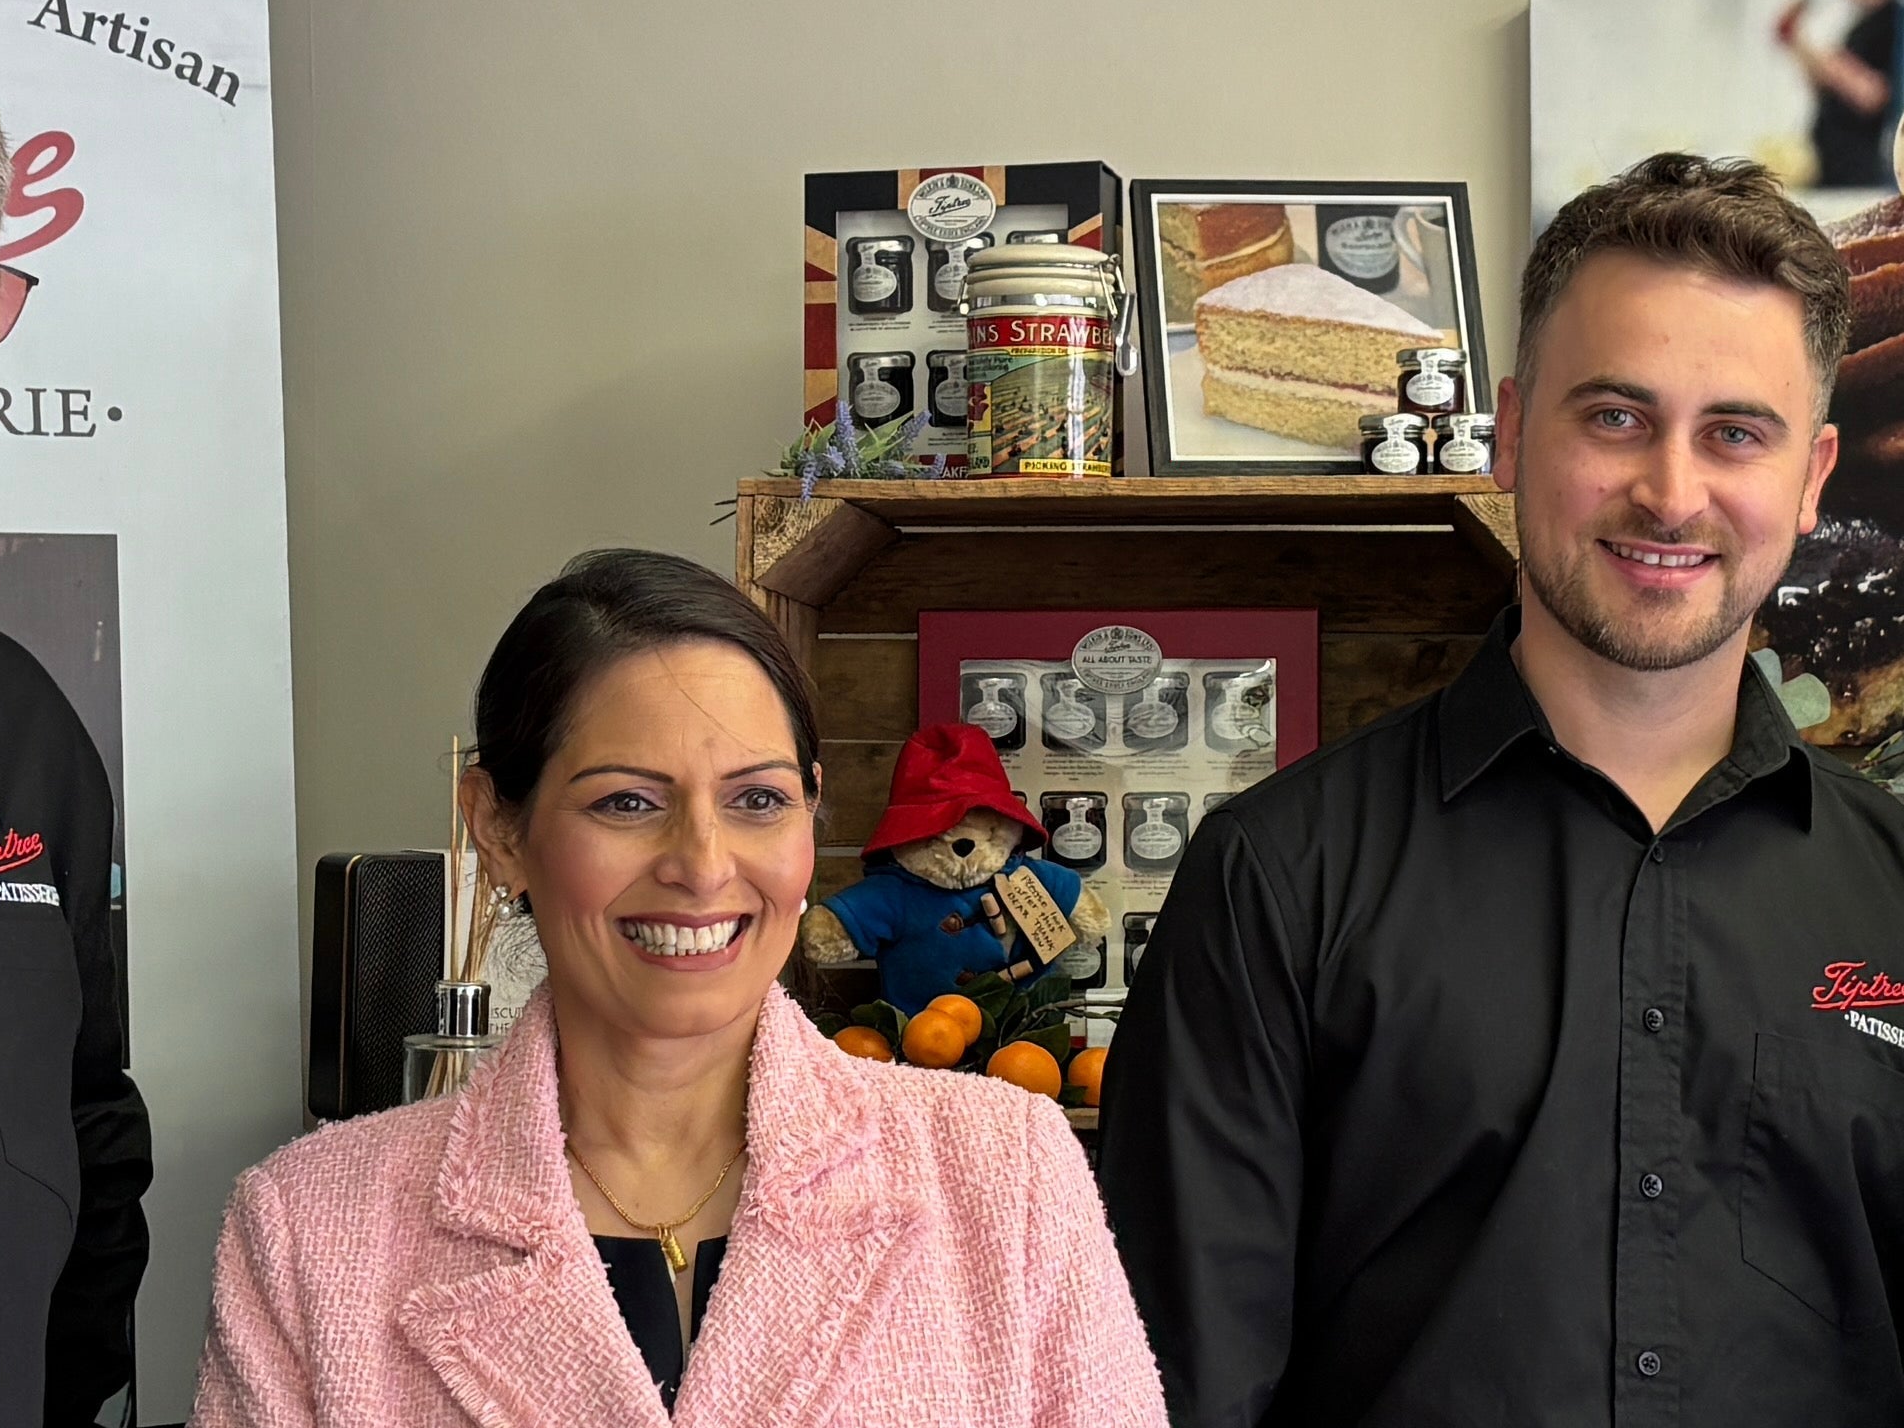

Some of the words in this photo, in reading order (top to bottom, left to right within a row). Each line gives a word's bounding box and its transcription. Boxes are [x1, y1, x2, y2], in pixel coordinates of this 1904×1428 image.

[1009, 319, 1113, 346] STRAWBE
[1024, 461, 1068, 471] PICKING
[1082, 655, 1095, 664] ALL
[1098, 655, 1125, 664] ABOUT
[1128, 655, 1152, 664] TASTE
[1020, 874, 1048, 908] Please
